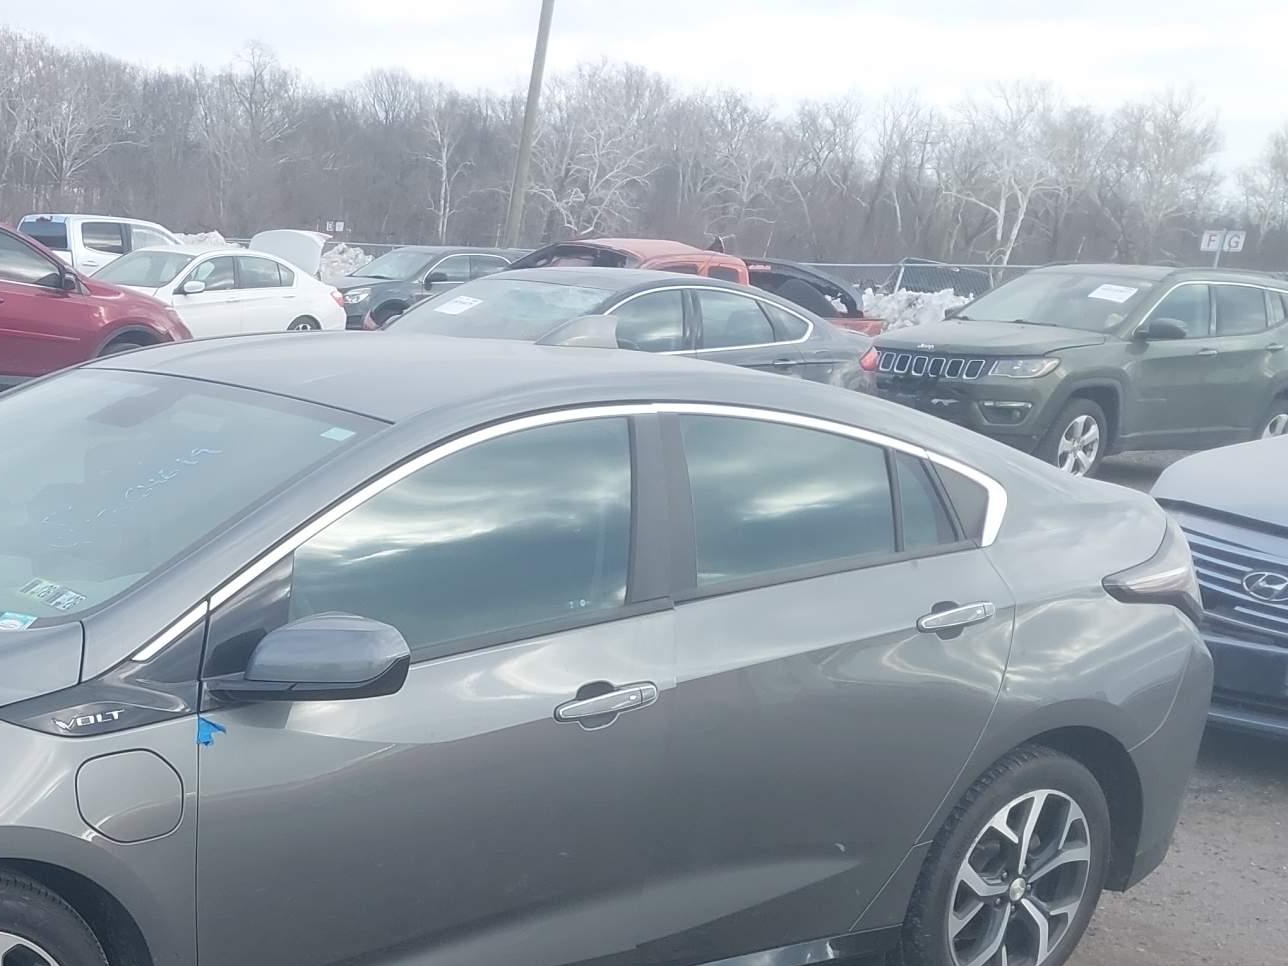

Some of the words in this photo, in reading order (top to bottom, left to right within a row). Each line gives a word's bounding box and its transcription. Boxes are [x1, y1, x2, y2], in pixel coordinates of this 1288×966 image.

[1207, 233, 1217, 249] F
[1228, 233, 1241, 249] G
[53, 708, 126, 730] VOLT
